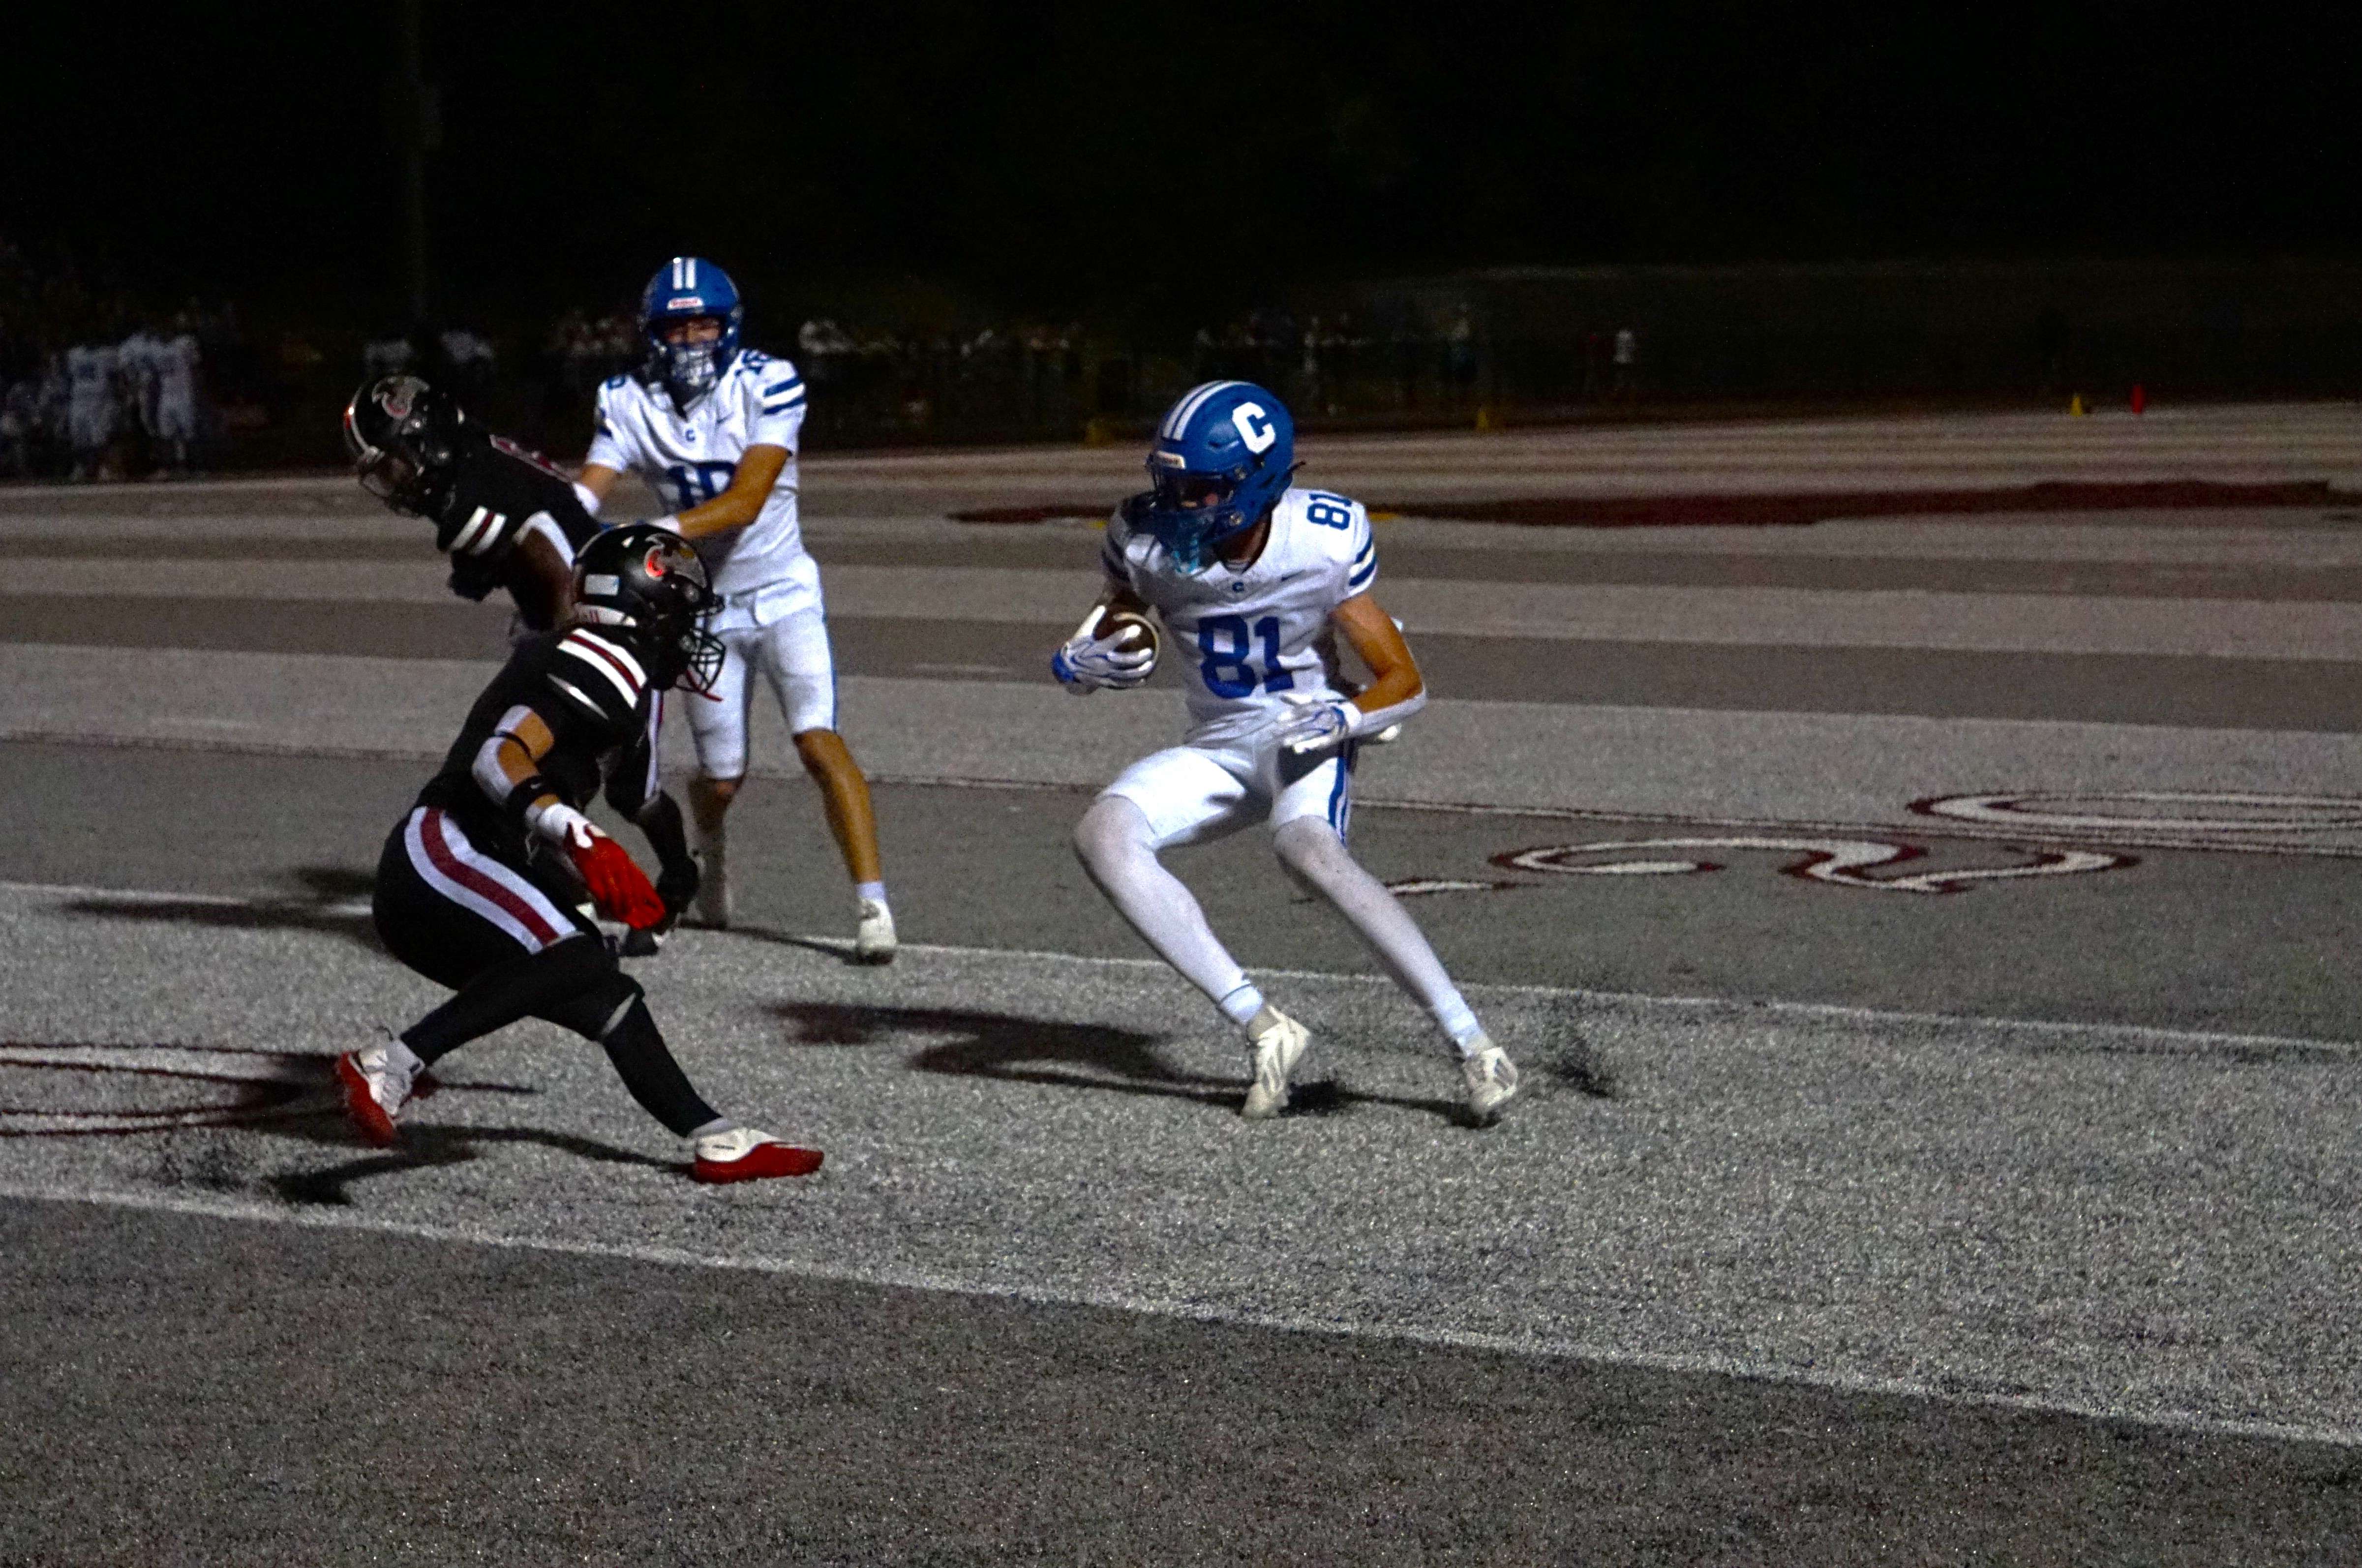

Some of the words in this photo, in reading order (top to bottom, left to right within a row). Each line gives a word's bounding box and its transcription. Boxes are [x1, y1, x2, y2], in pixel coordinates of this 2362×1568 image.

[685, 429, 695, 442] C
[1232, 401, 1276, 454] C
[1307, 494, 1351, 531] 81
[1232, 582, 1244, 592] C
[1199, 615, 1294, 698] 81
